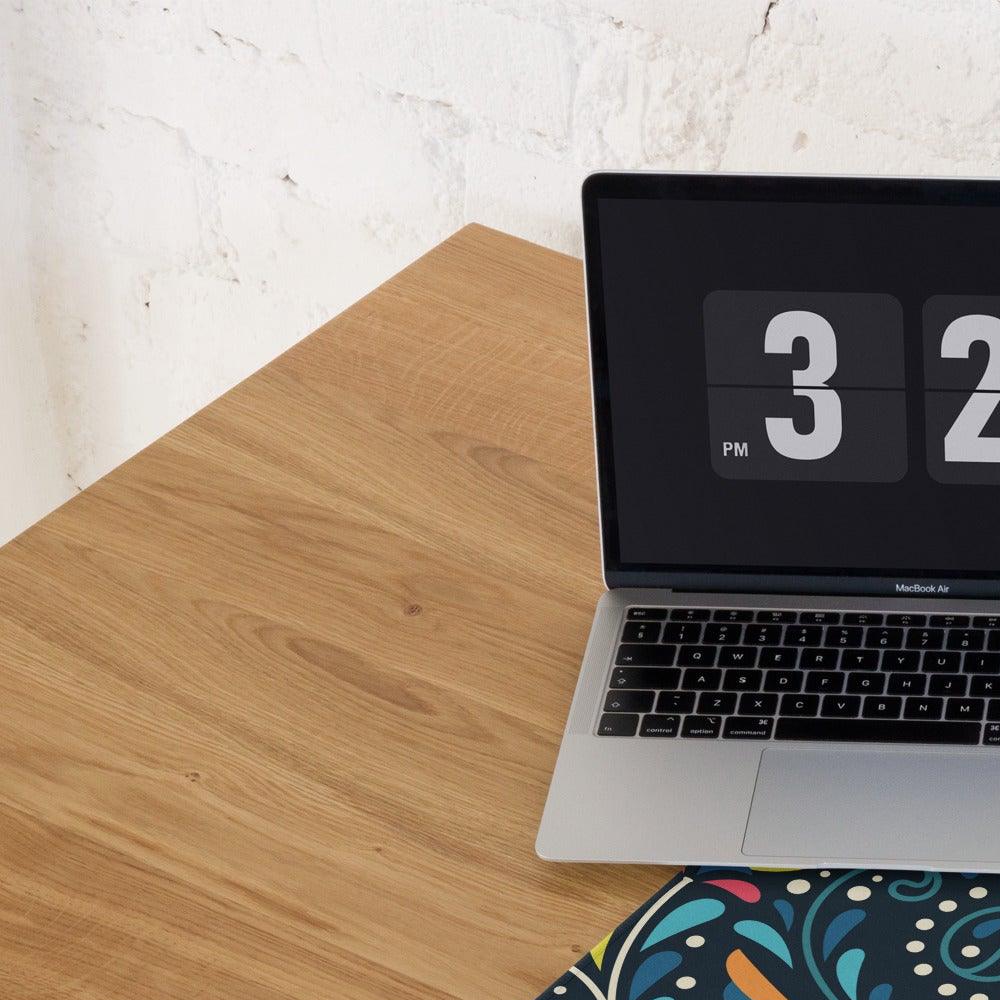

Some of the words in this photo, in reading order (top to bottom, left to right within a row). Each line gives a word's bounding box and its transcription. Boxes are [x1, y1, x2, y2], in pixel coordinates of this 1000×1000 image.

[764, 311, 842, 460] 3
[723, 441, 749, 457] PM
[896, 584, 936, 592] MacBook
[937, 584, 950, 593] Air
